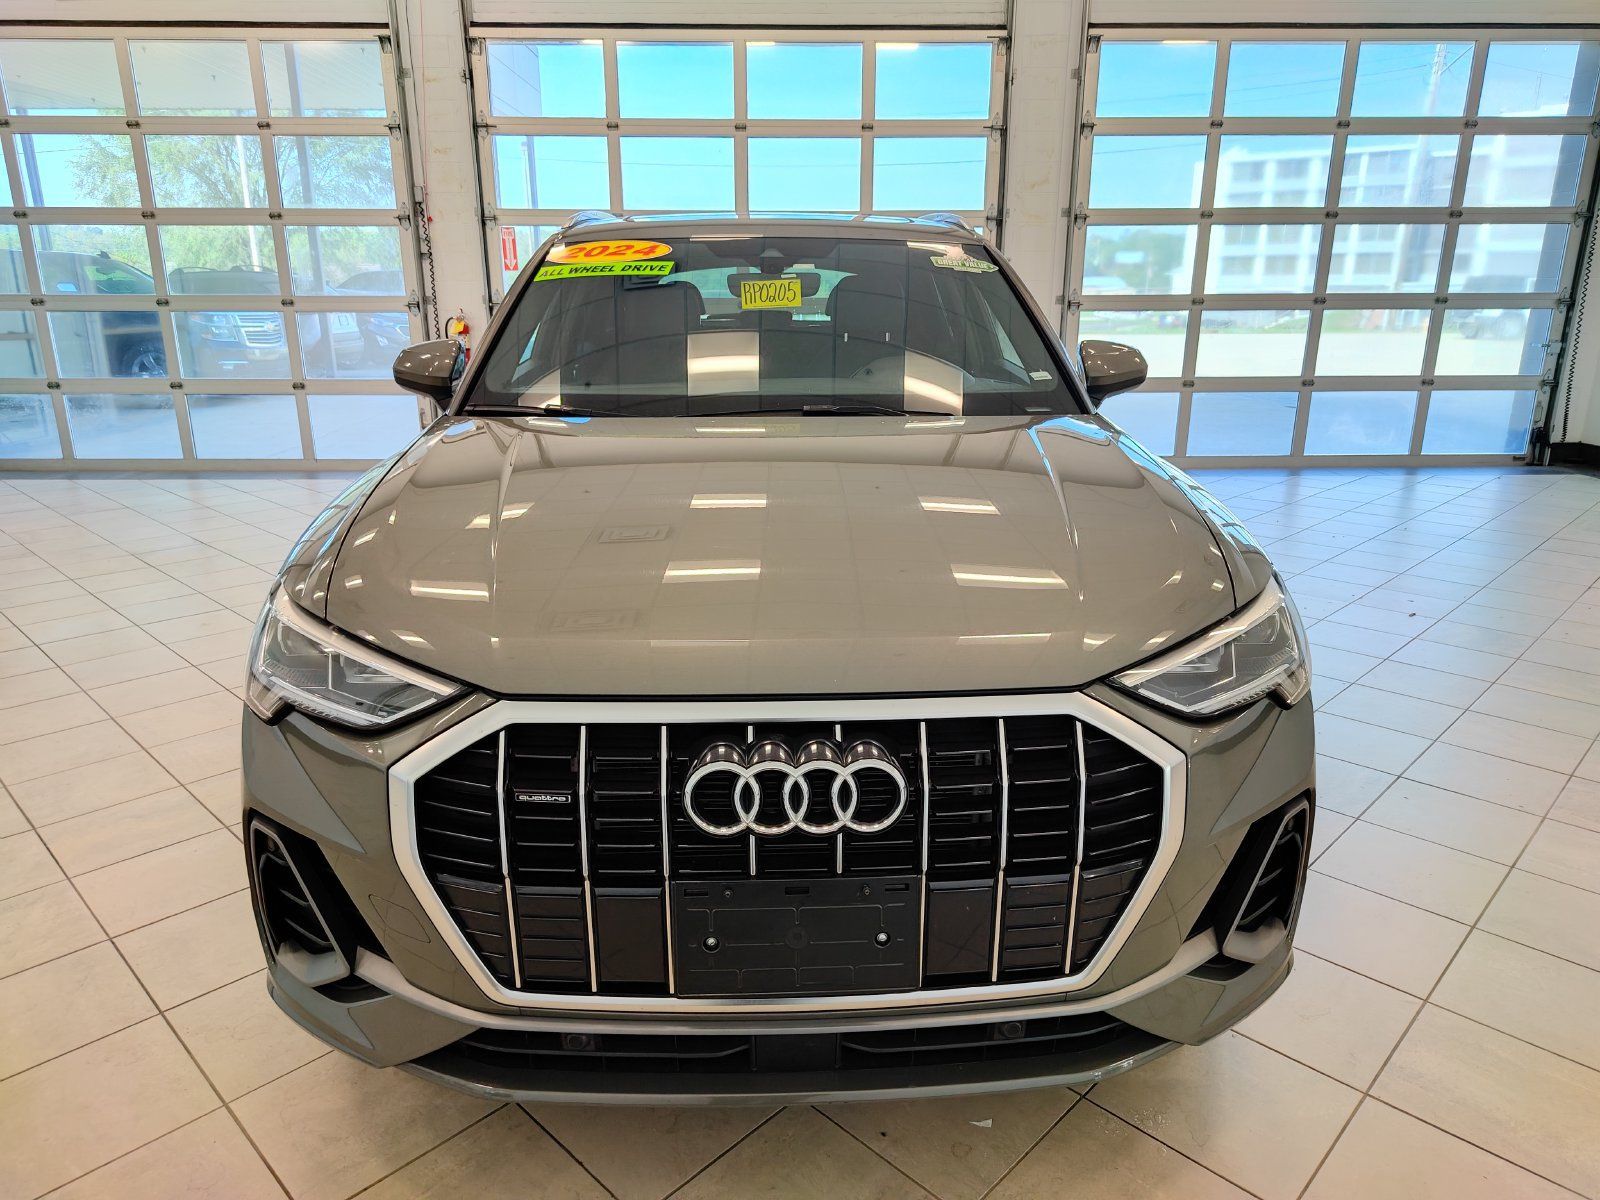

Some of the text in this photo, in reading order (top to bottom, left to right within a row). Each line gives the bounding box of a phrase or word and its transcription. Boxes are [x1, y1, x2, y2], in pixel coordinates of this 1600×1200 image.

[559, 245, 661, 259] 2024
[539, 264, 669, 277] ALL WHEEL DRIVE
